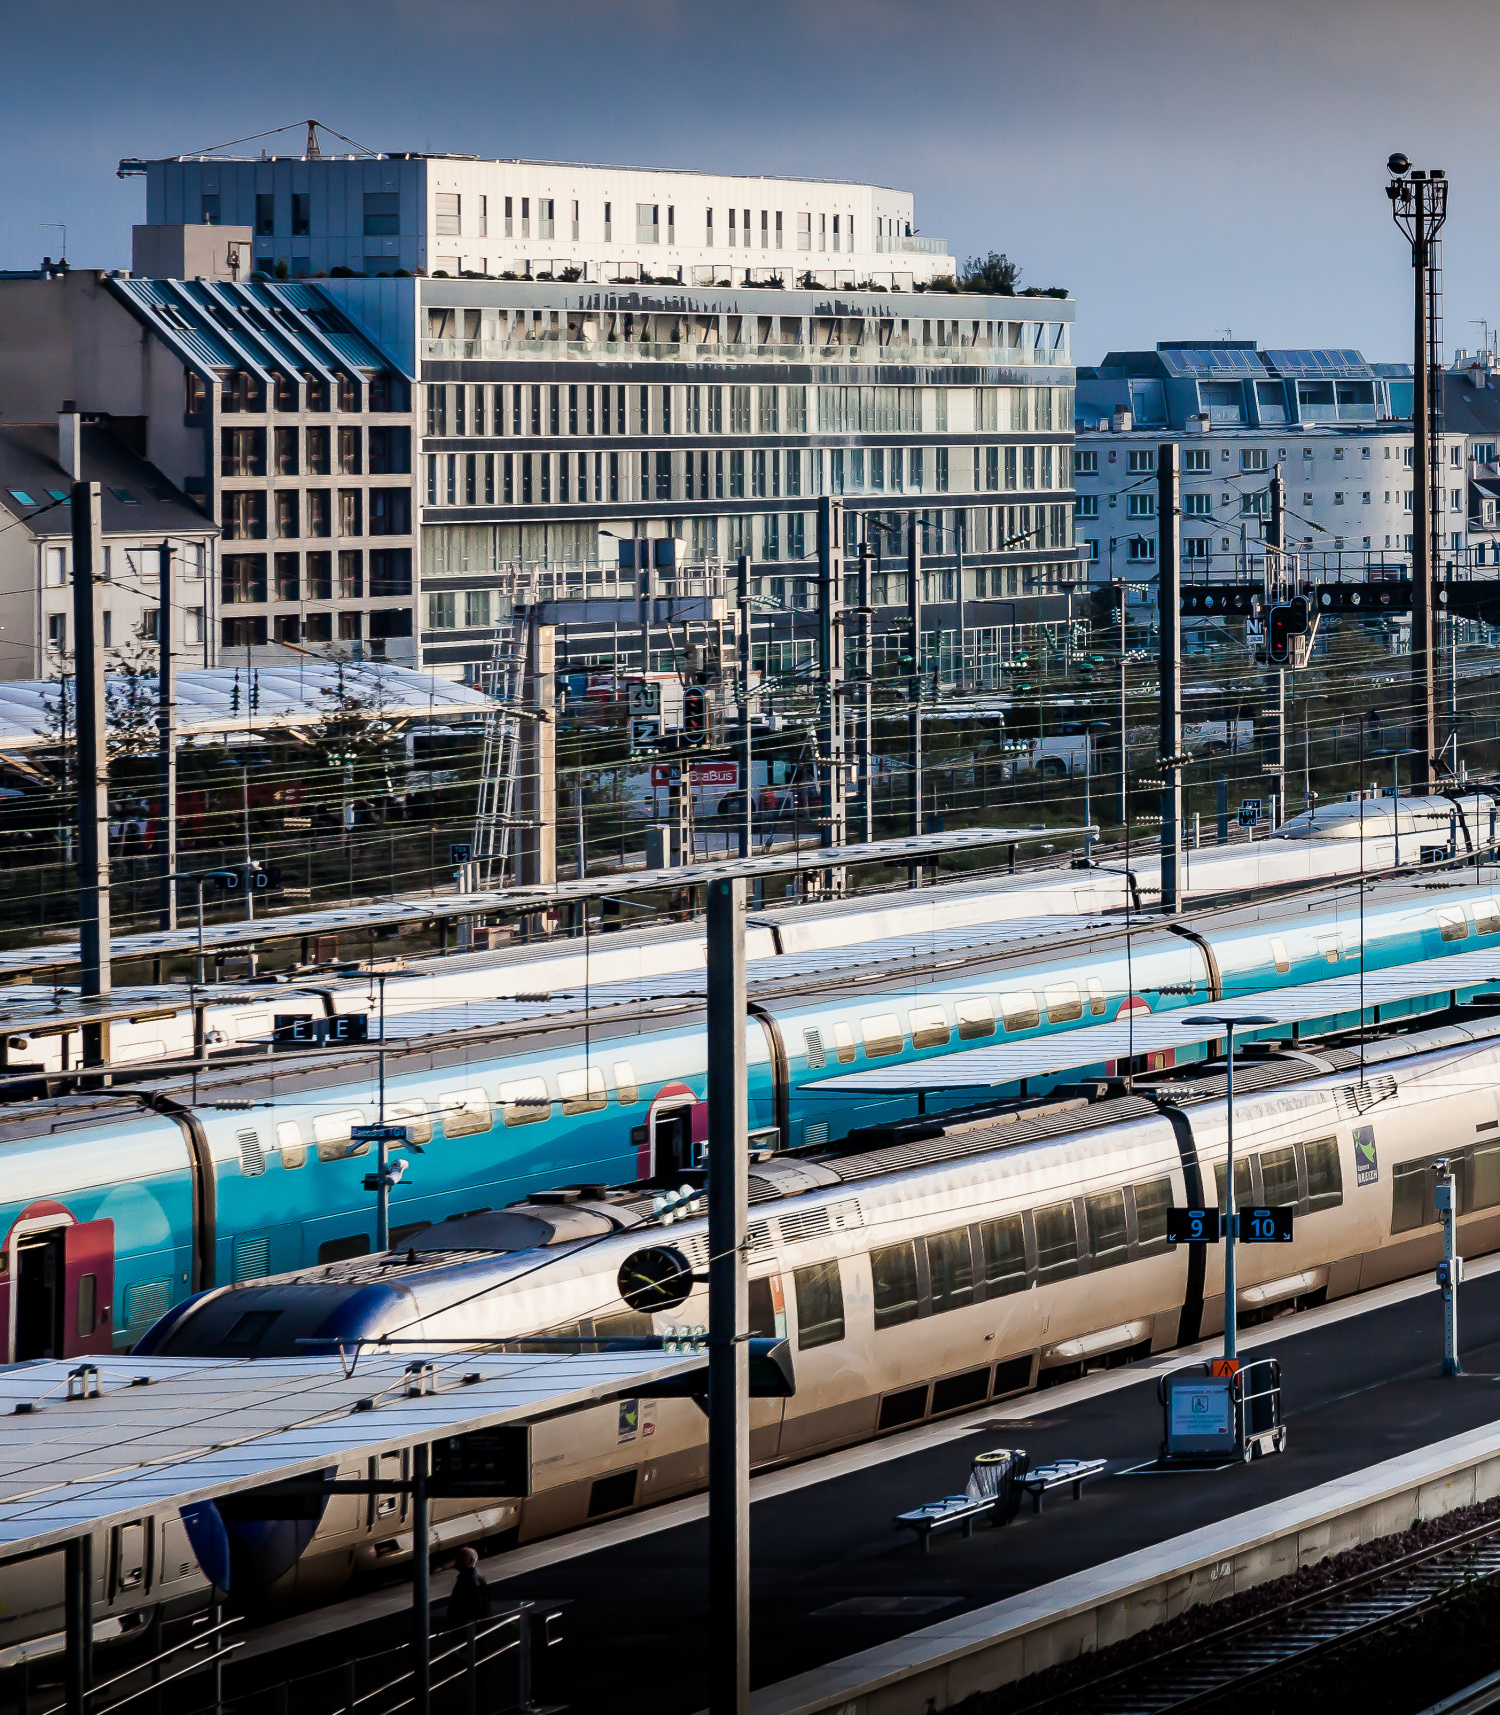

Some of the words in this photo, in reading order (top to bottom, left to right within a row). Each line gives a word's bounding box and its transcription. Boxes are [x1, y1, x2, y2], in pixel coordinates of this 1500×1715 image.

[1246, 619, 1263, 634] Nr
[638, 725, 654, 742] Z
[256, 873, 268, 888] D
[294, 1020, 306, 1037] E
[337, 1020, 349, 1037] E
[1191, 1220, 1202, 1237] 9
[1250, 1218, 1275, 1237] 10
